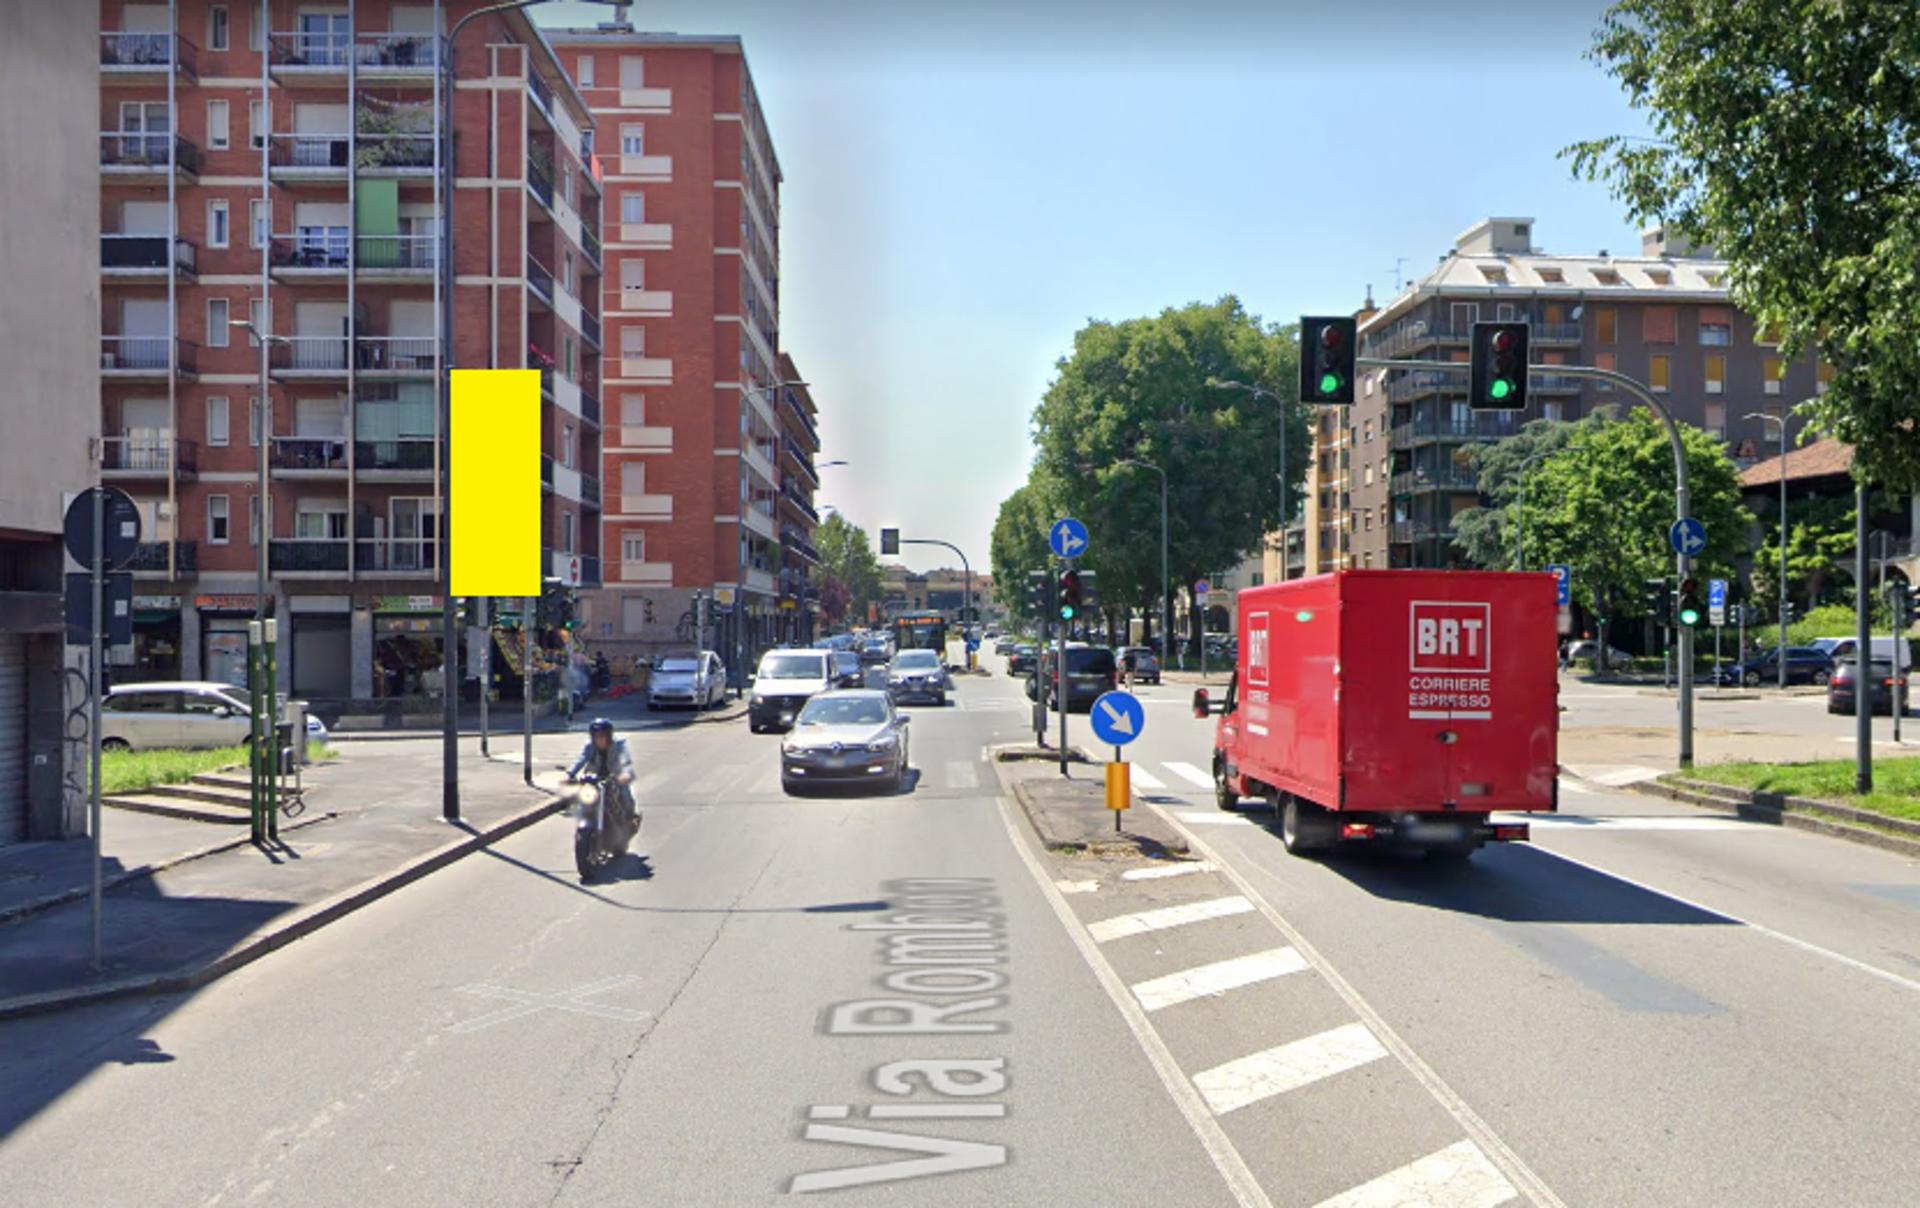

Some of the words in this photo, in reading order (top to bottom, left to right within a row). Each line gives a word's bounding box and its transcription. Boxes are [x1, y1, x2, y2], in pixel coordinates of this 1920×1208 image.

[1418, 618, 1483, 656] BRT
[1409, 677, 1490, 691] CORRIERE
[1409, 693, 1491, 708] ESPRESSO
